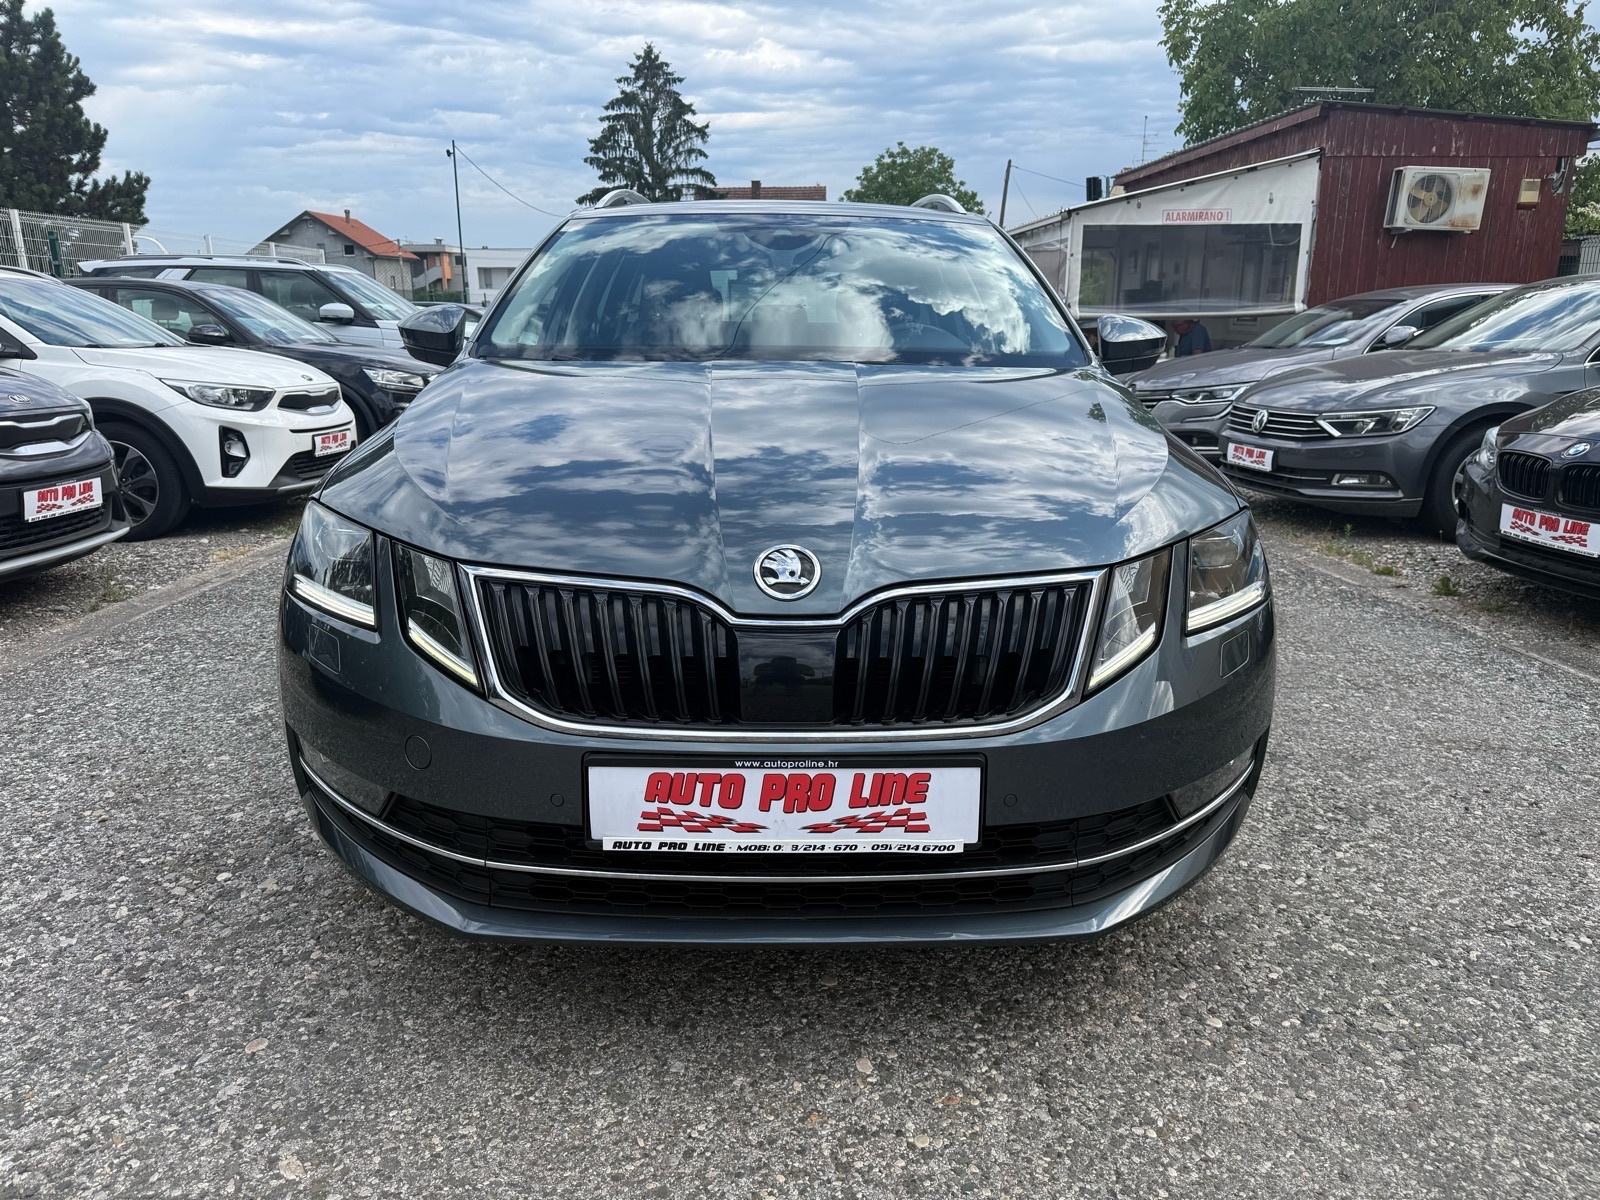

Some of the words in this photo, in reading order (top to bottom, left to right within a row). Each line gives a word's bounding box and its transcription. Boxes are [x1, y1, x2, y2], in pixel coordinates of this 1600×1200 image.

[1165, 211, 1224, 222] ALARMIRANO
[37, 487, 59, 502] AUTO
[61, 484, 77, 500] PRO
[79, 481, 93, 496] LINE
[1512, 508, 1536, 526] AUTO
[1538, 514, 1560, 532] PRO
[1563, 520, 1590, 536] LINE
[735, 760, 839, 769] www.autoproline.hr
[644, 772, 746, 809] AUTO
[758, 773, 837, 813] PRO
[848, 772, 932, 809] LINE
[612, 841, 652, 850] AUTO
[658, 842, 688, 850] PRO
[694, 842, 726, 851] LINE
[922, 844, 956, 852] 6700
